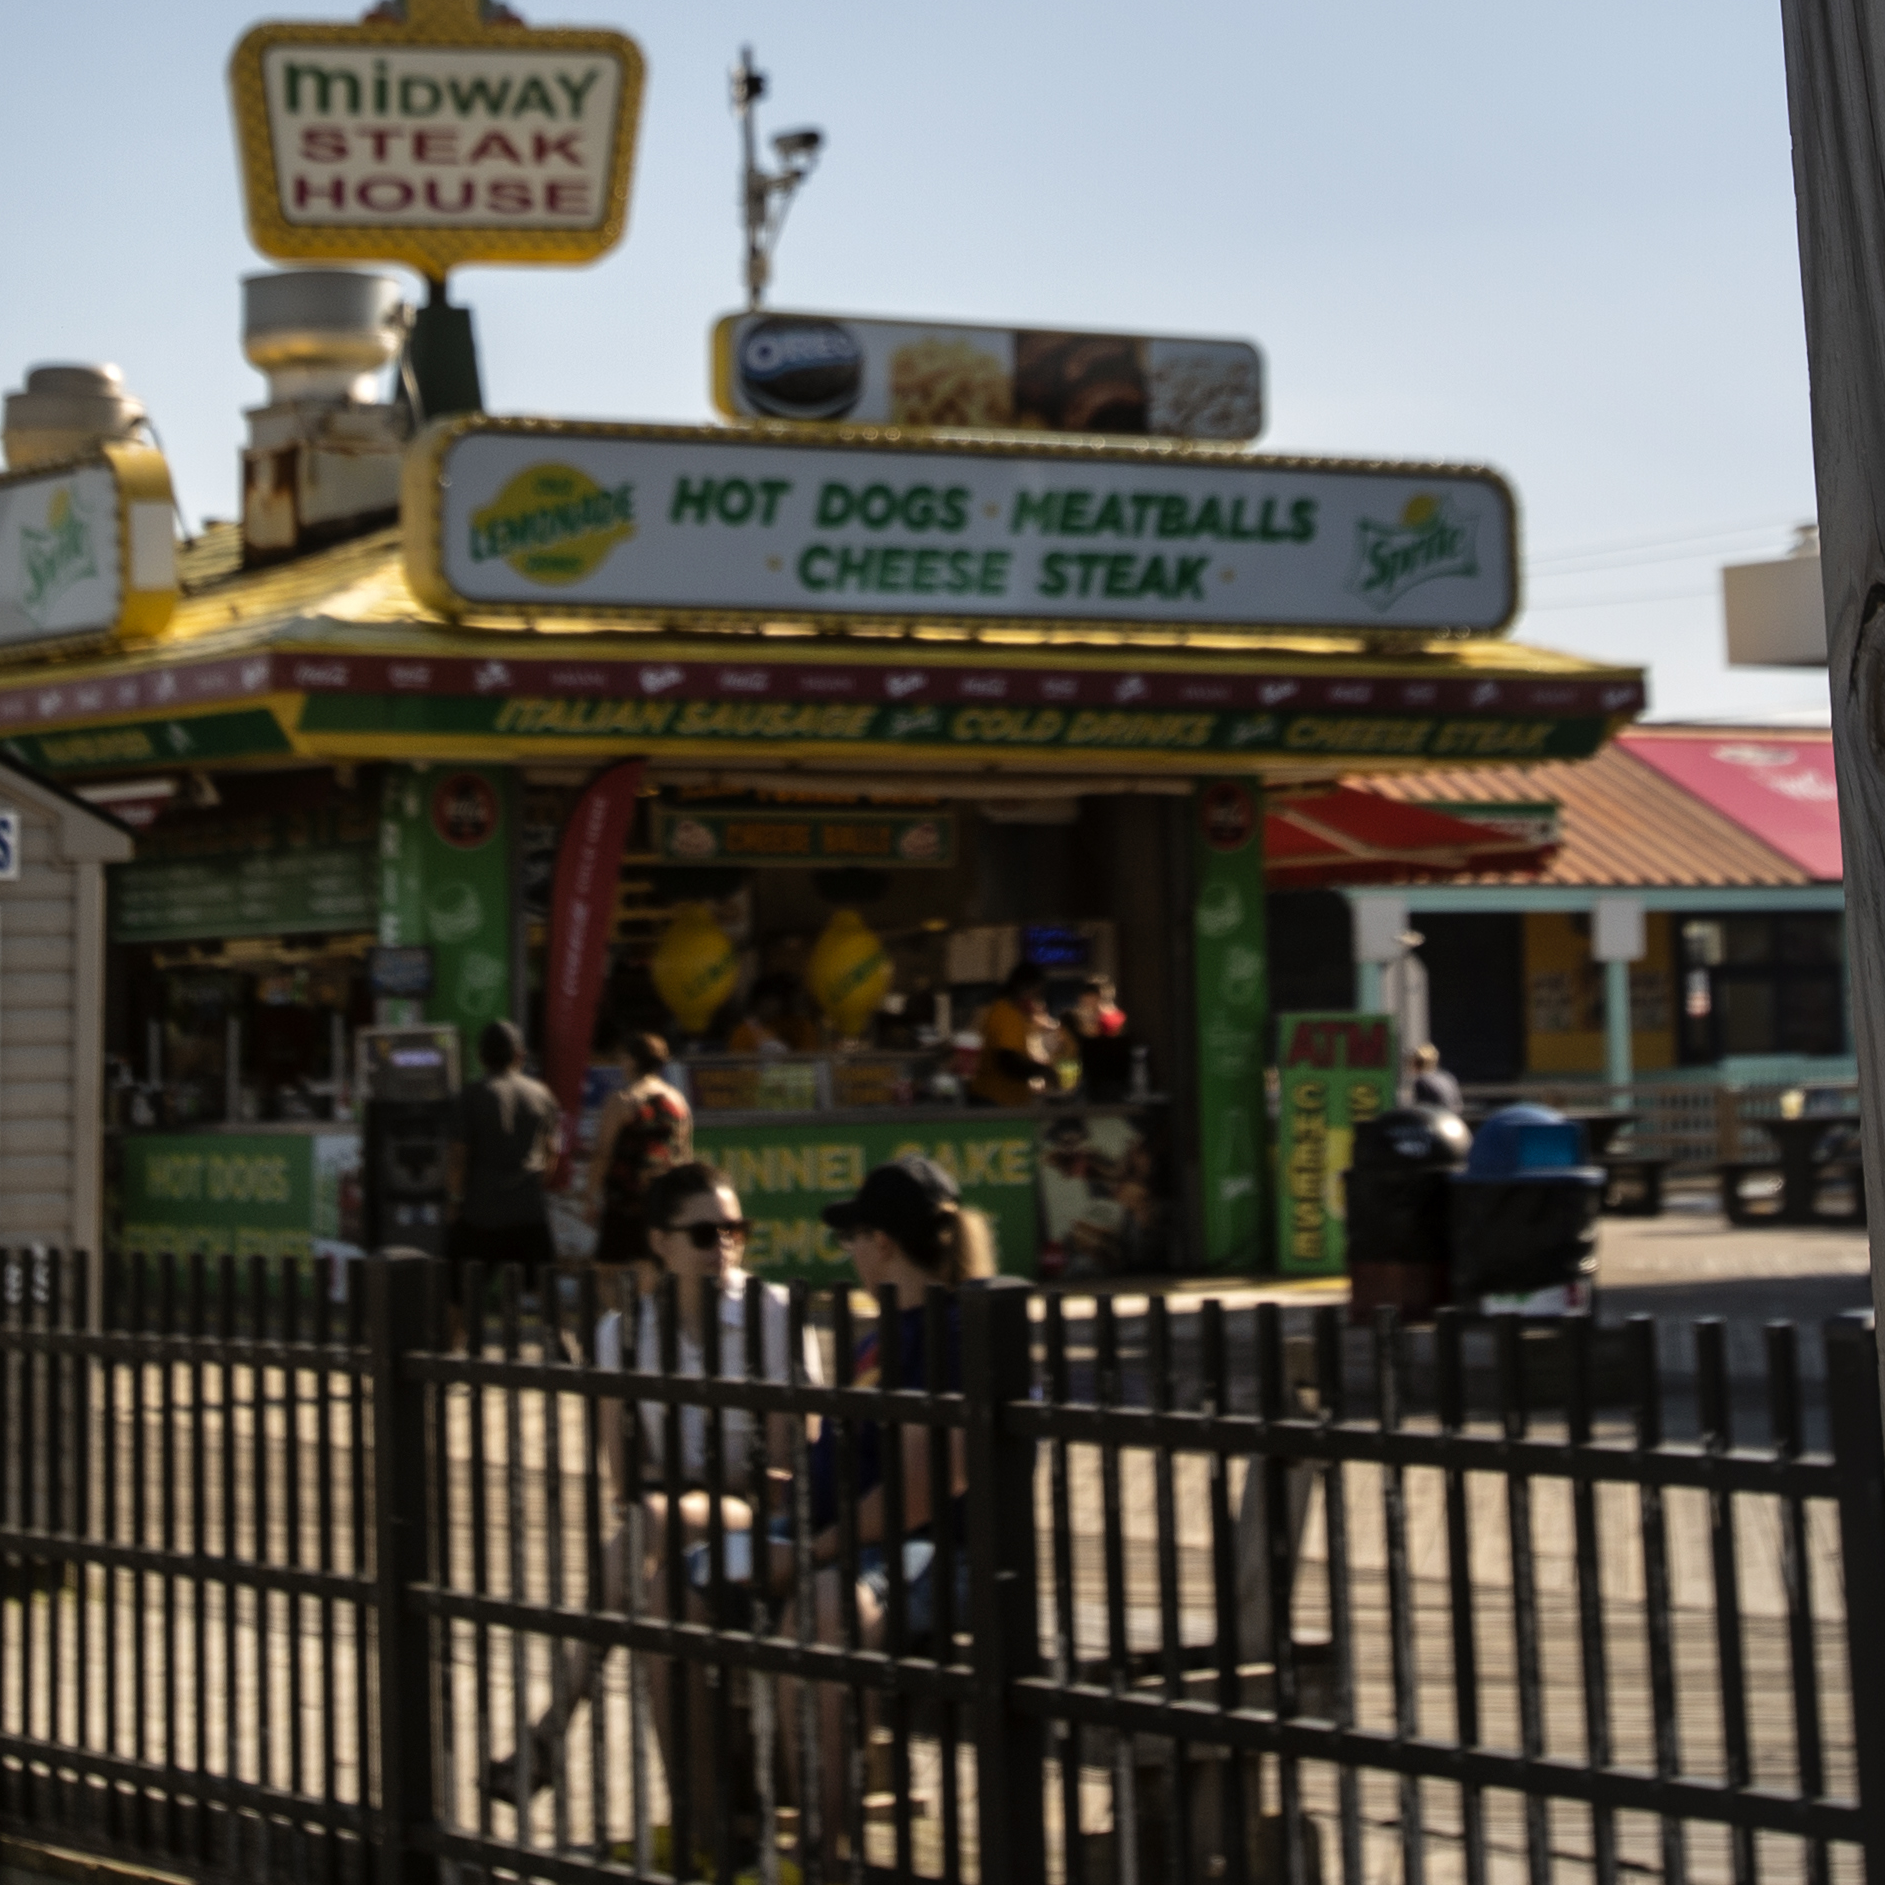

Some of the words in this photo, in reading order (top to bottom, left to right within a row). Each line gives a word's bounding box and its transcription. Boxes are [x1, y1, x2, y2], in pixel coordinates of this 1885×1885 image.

[299, 126, 584, 166] STEAK
[294, 176, 592, 215] HOUSE
[670, 476, 794, 527] HOT
[815, 481, 971, 532] DOGS
[1010, 487, 1319, 543] MEATBALLS
[798, 544, 1011, 596] CHEESE
[1038, 551, 1211, 600] STEAK
[1363, 524, 1464, 594] Sprite
[496, 697, 674, 734] ITALIAN
[676, 701, 878, 737] SAUSAGE
[952, 708, 1062, 742] COLD
[1288, 1022, 1390, 1069] ATM
